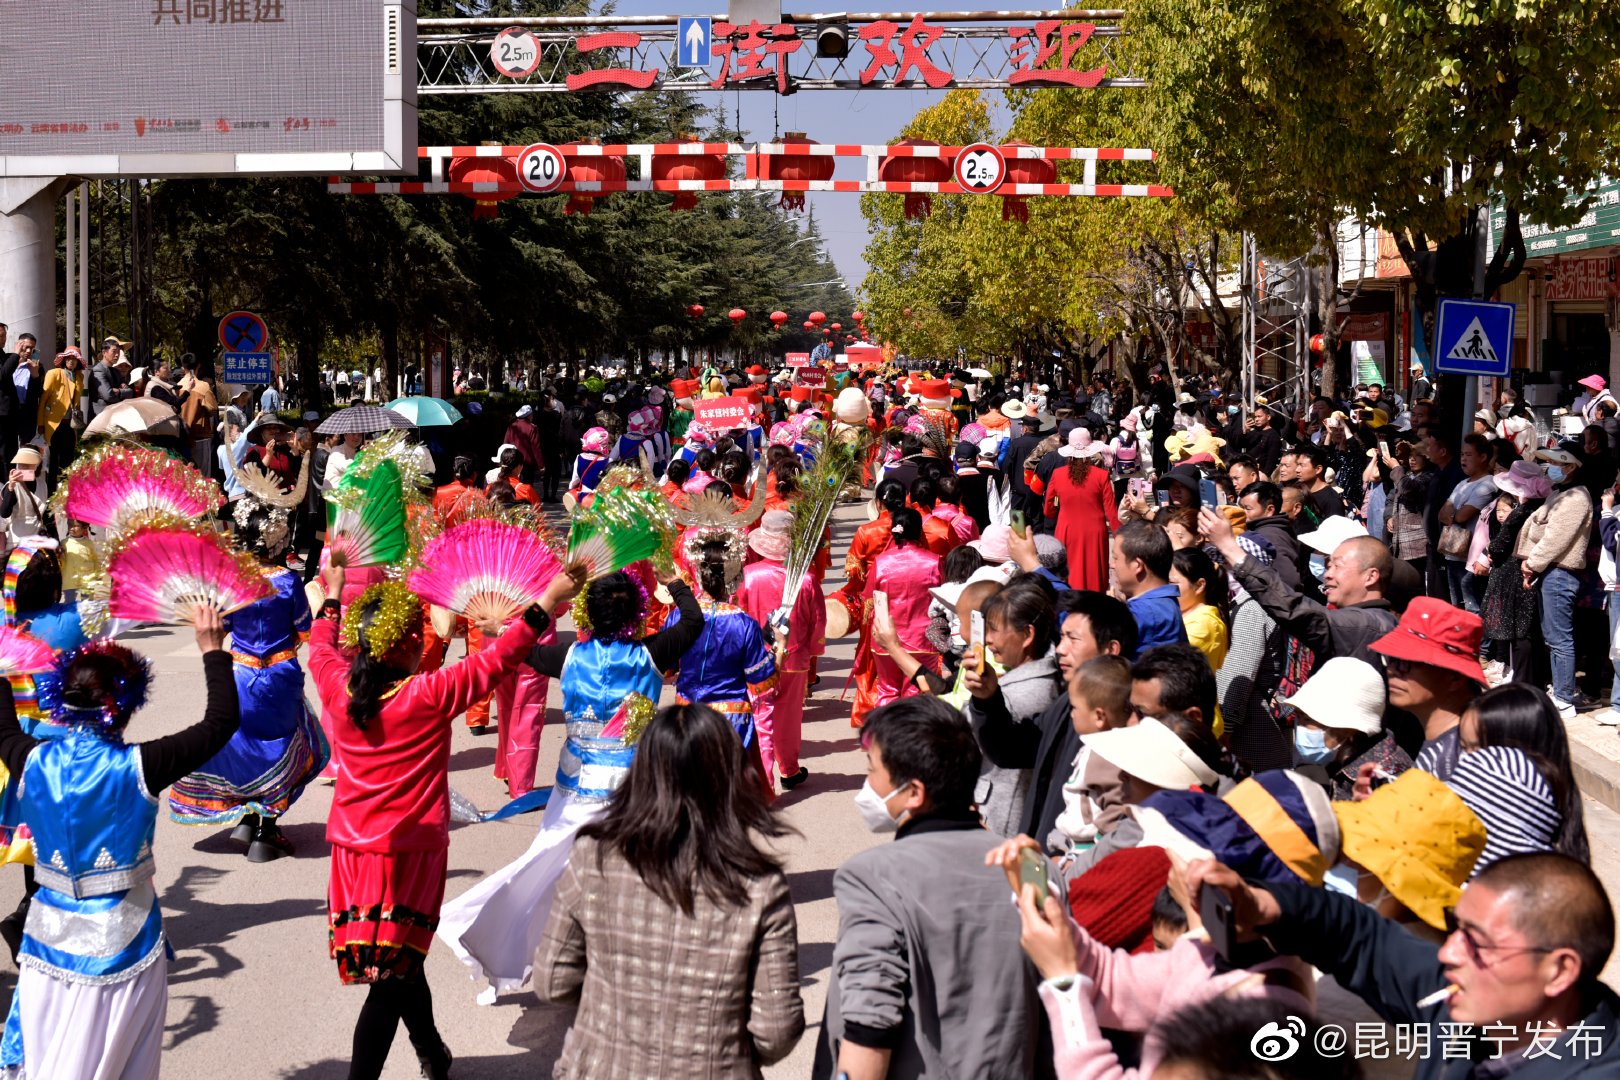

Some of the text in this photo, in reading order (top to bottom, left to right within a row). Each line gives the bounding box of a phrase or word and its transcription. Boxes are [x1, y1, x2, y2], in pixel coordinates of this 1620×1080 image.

[151, 0, 284, 25] 共同推进
[501, 42, 533, 62] 2.5m
[565, 12, 1108, 94] 二街欢迎
[529, 155, 555, 180] 20
[966, 158, 995, 180] 2.5m
[226, 357, 268, 370] 禁止停车
[700, 406, 744, 419] 朱家营村委会
